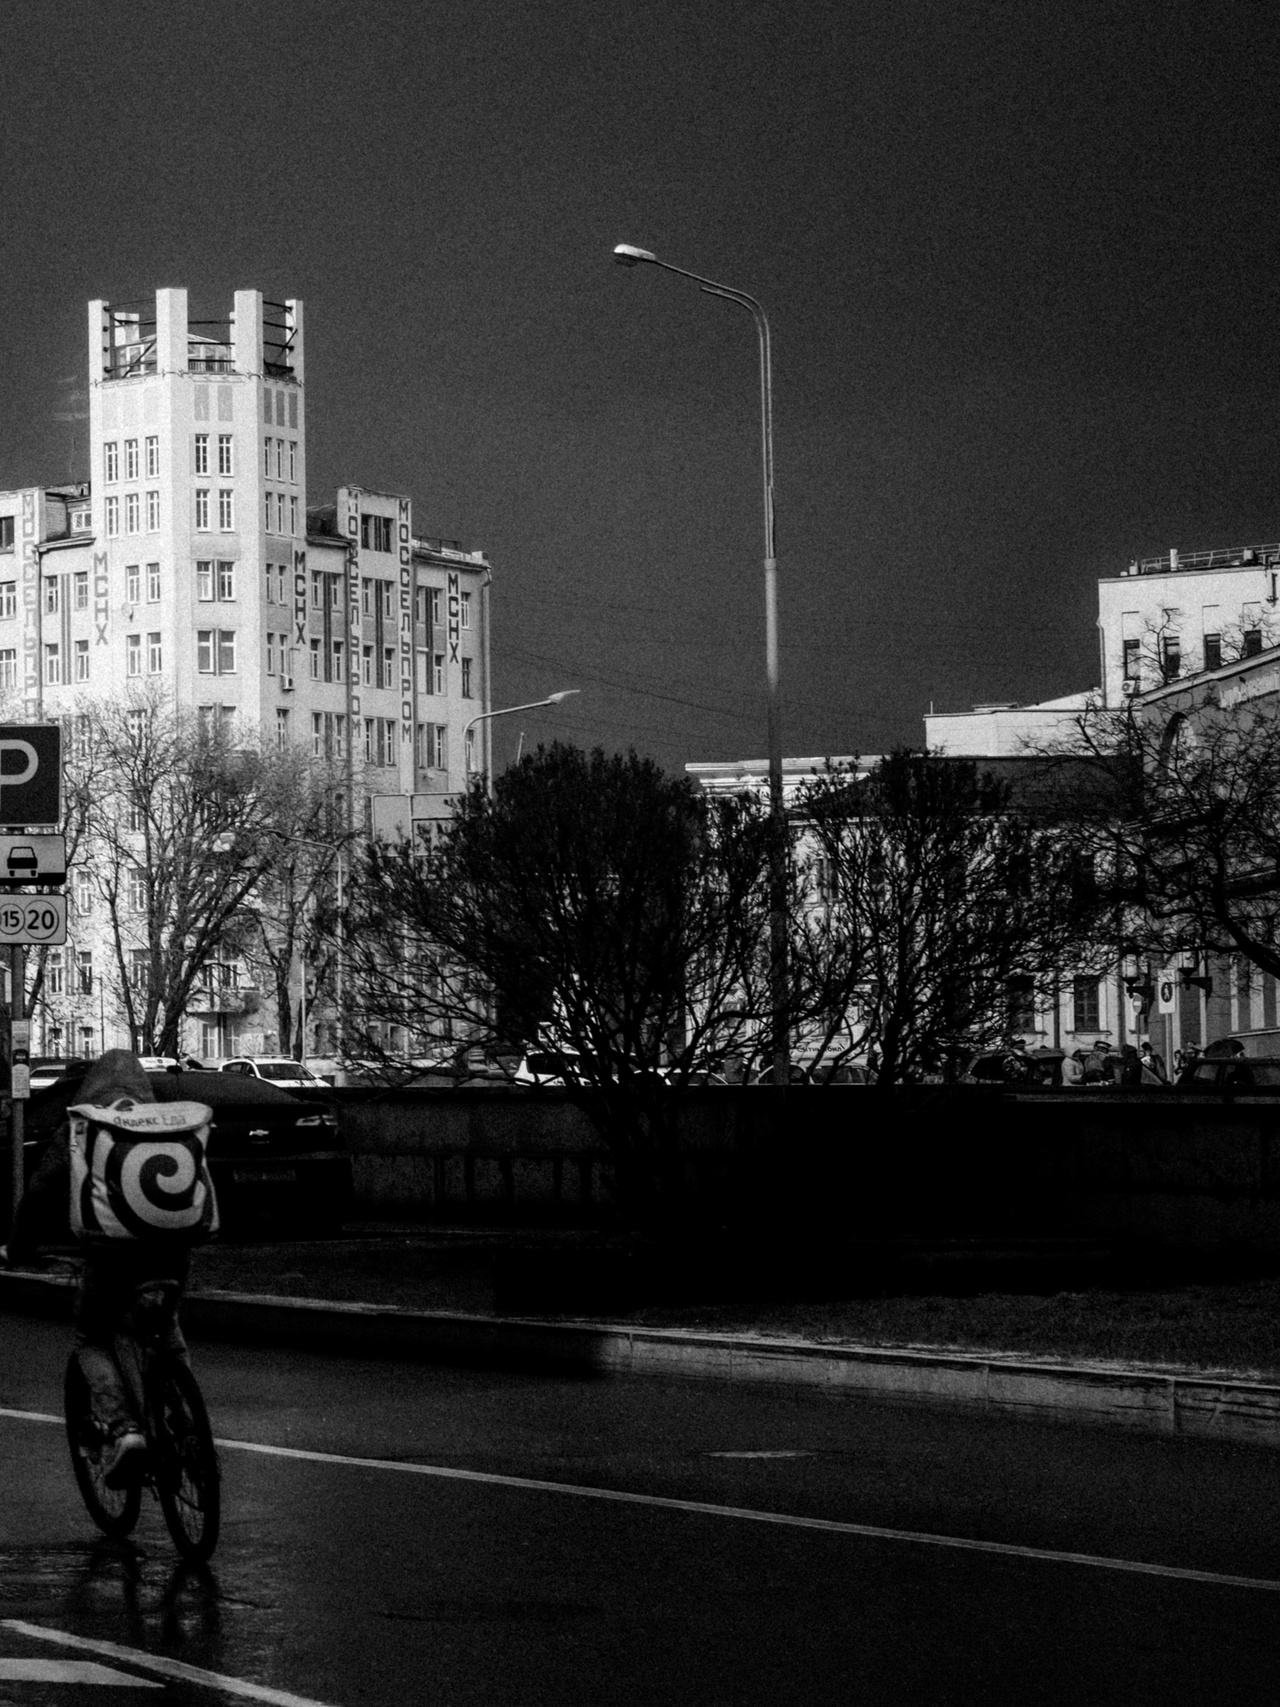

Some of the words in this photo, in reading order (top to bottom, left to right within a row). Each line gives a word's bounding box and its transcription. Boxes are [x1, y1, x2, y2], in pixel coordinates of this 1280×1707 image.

[22, 493, 39, 724] МОССЕЛЬПРО
[94, 551, 109, 646] МСНХ
[294, 550, 307, 645] МСНХ
[398, 499, 412, 743] МОССЕЛЬПРОМ
[448, 572, 460, 664] МСНХ
[2, 910, 20, 928] 15
[27, 909, 55, 931] 20
[113, 1115, 158, 1128] Яндекс
